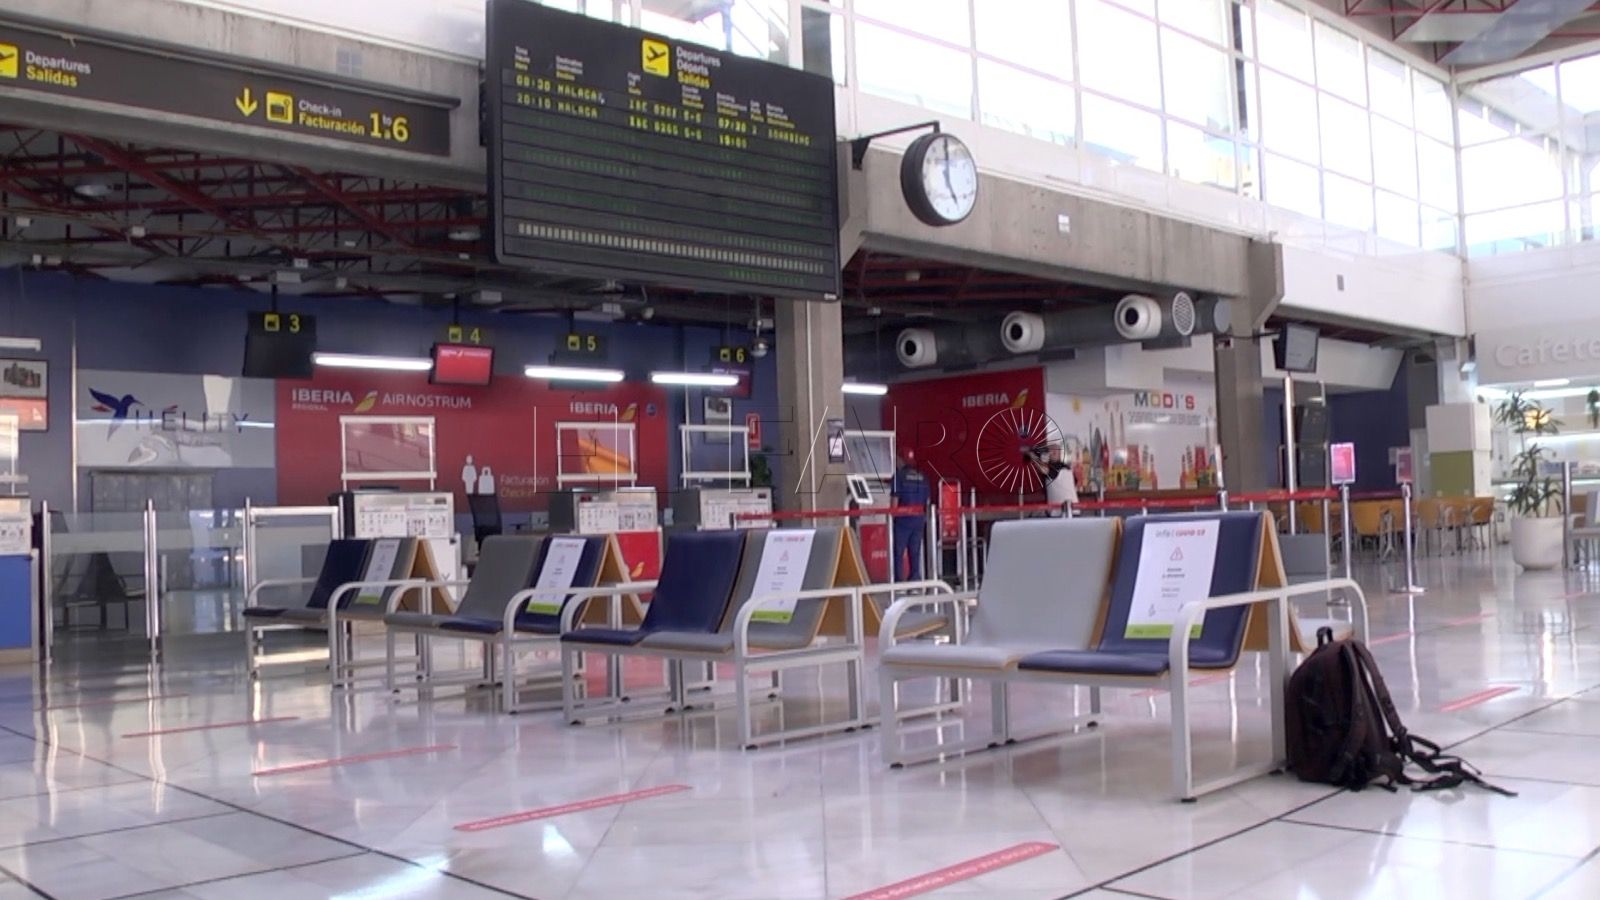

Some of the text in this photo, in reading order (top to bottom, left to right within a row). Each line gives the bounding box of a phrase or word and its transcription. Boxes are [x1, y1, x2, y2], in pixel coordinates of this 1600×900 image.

[25, 50, 92, 75] Departures
[676, 45, 721, 68] Departures
[25, 64, 78, 88] Salidas
[677, 70, 711, 90] Salidas
[298, 99, 342, 117] Check-in
[298, 111, 366, 136] Facturación
[369, 112, 382, 138] 1
[392, 116, 409, 142] 6
[288, 314, 300, 333] 3
[469, 327, 481, 344] 4
[586, 335, 597, 351] 5
[736, 349, 745, 363] 6
[291, 388, 354, 404] IBERIA
[962, 392, 1010, 408] IBERIA
[569, 401, 617, 415] IBERIA
